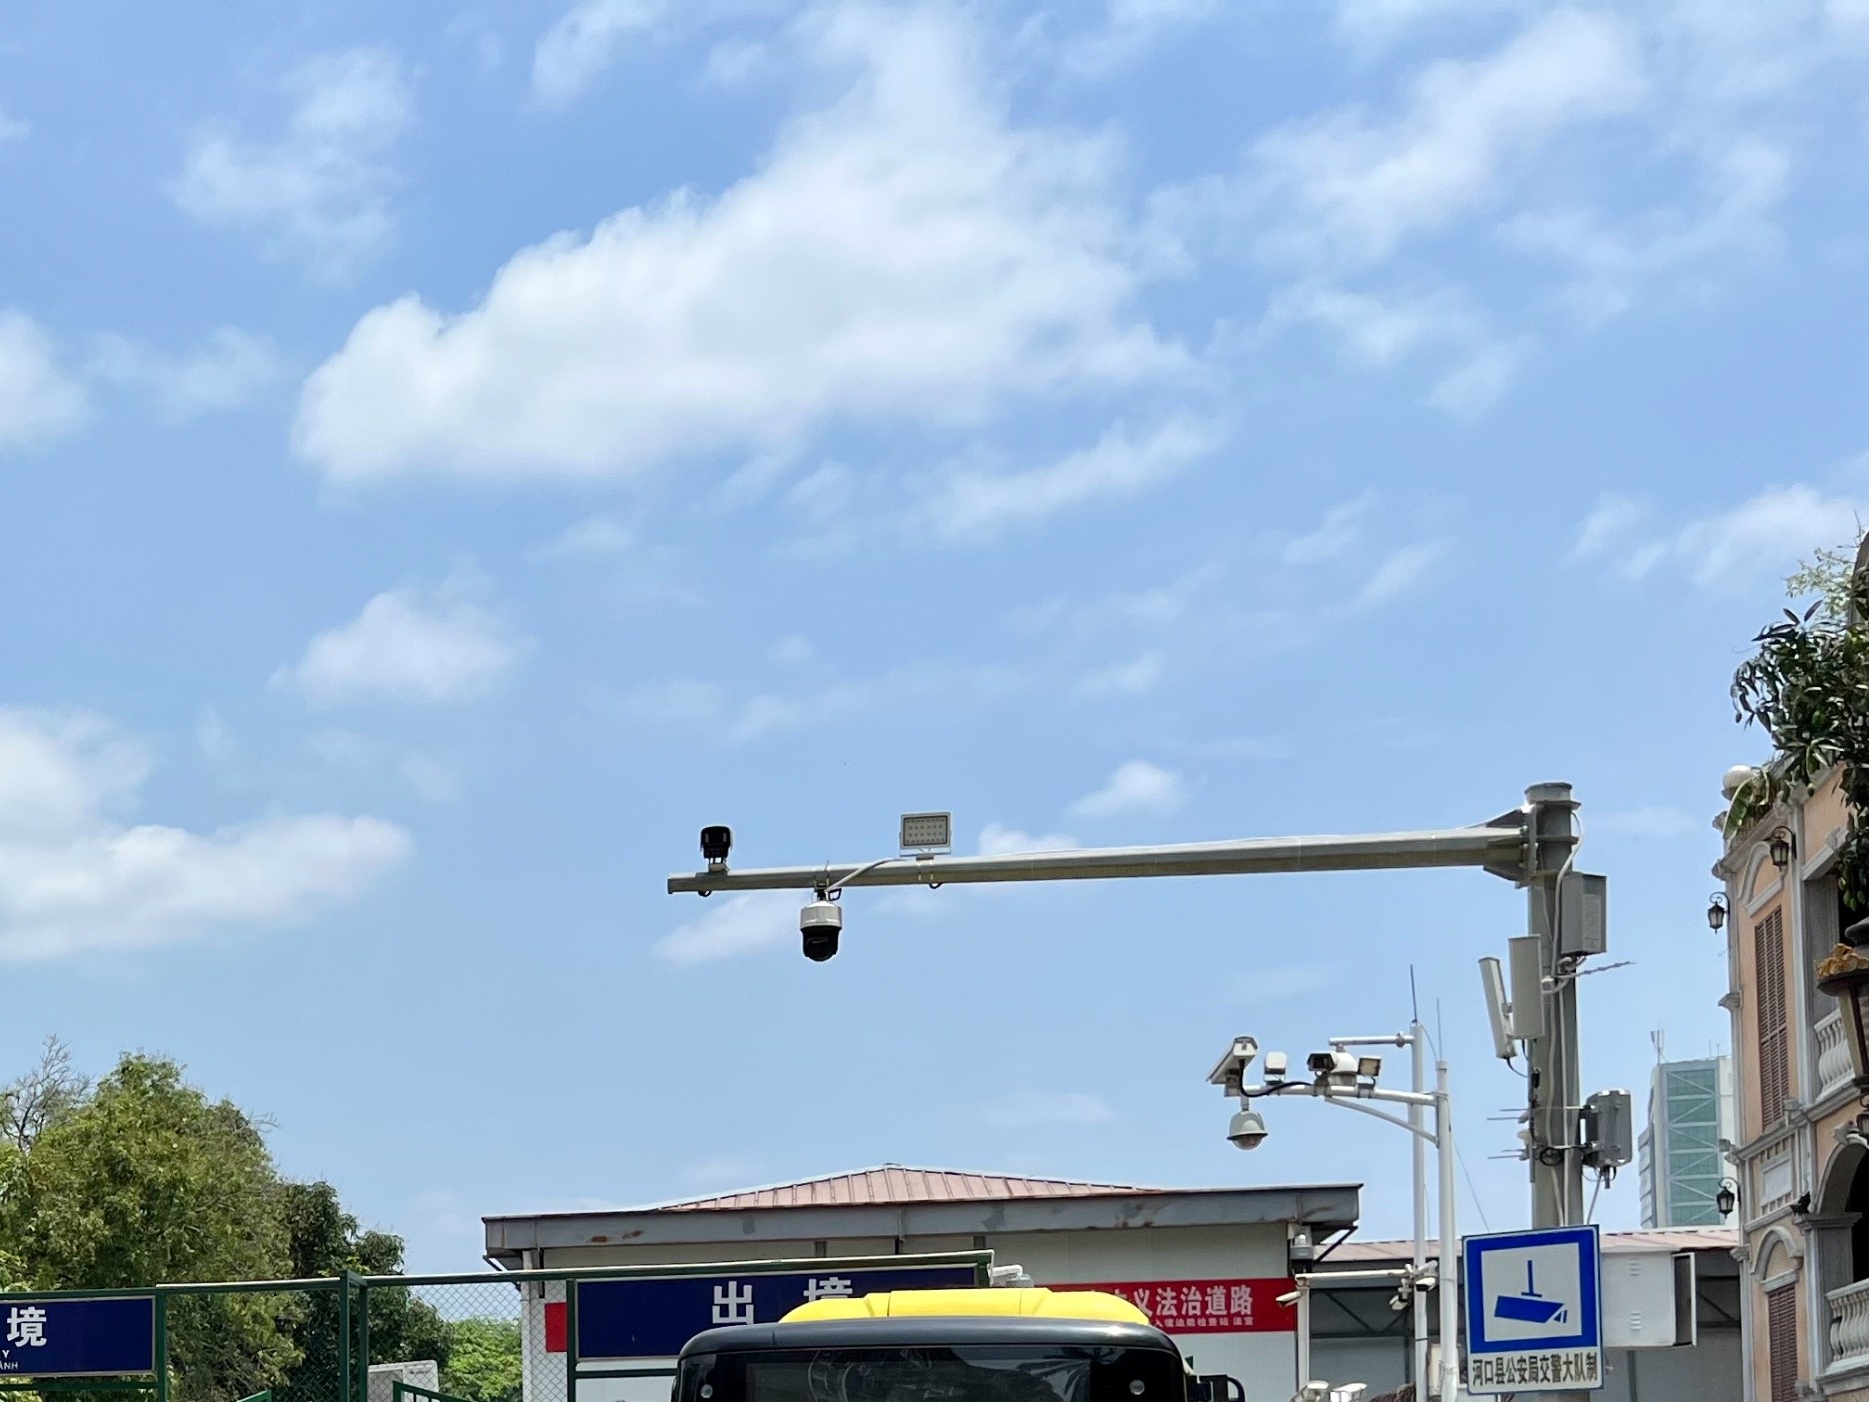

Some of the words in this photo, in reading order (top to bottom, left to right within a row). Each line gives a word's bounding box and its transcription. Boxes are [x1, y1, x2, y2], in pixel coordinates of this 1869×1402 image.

[1116, 1285, 1253, 1318] 义法治道路
[1472, 1352, 1598, 1387] 河口县公安局交警大队制
